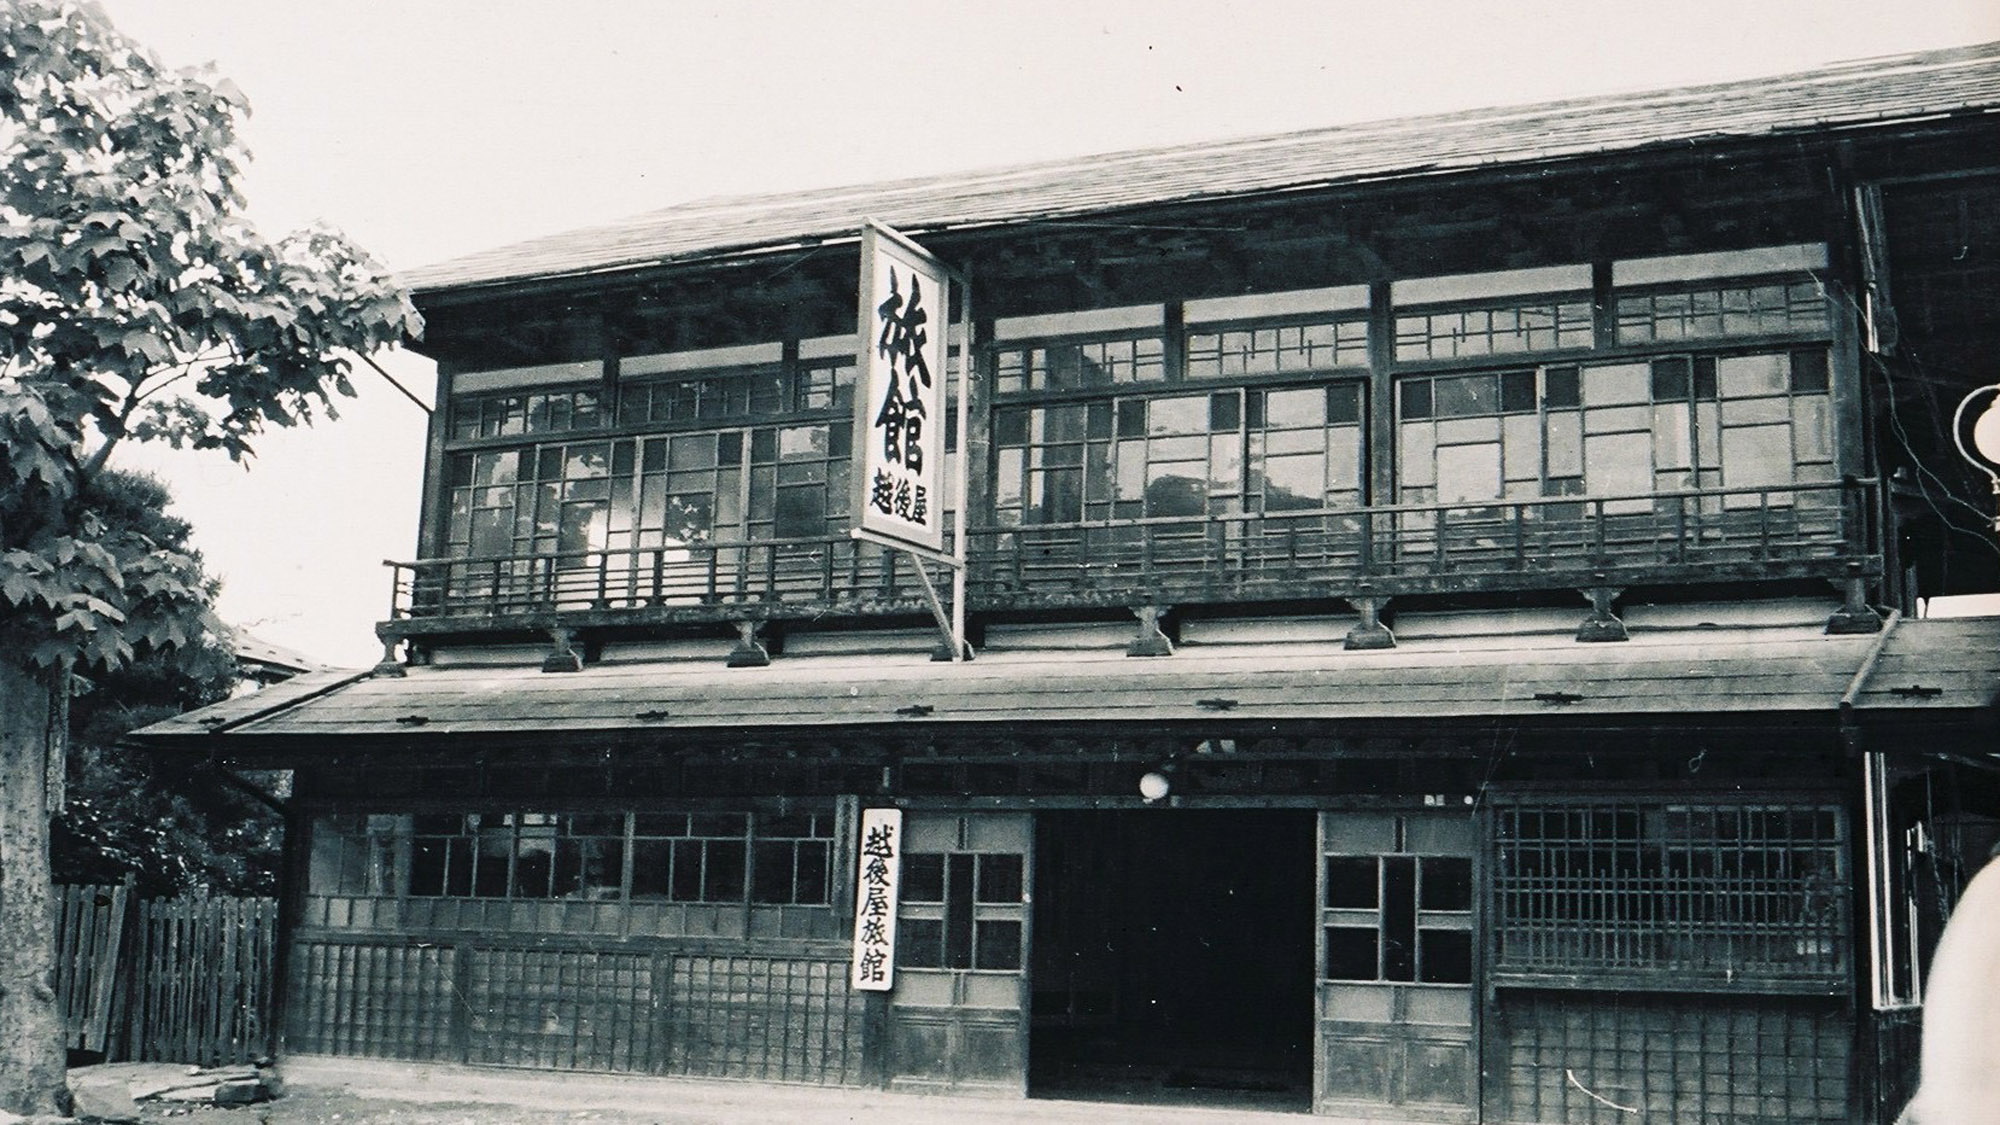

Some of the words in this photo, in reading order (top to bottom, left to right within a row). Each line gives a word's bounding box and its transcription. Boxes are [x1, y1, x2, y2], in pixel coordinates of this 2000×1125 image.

[875, 265, 931, 476] 旅館
[869, 467, 927, 526] 越後屋
[860, 824, 894, 982] 越後屋旅館
